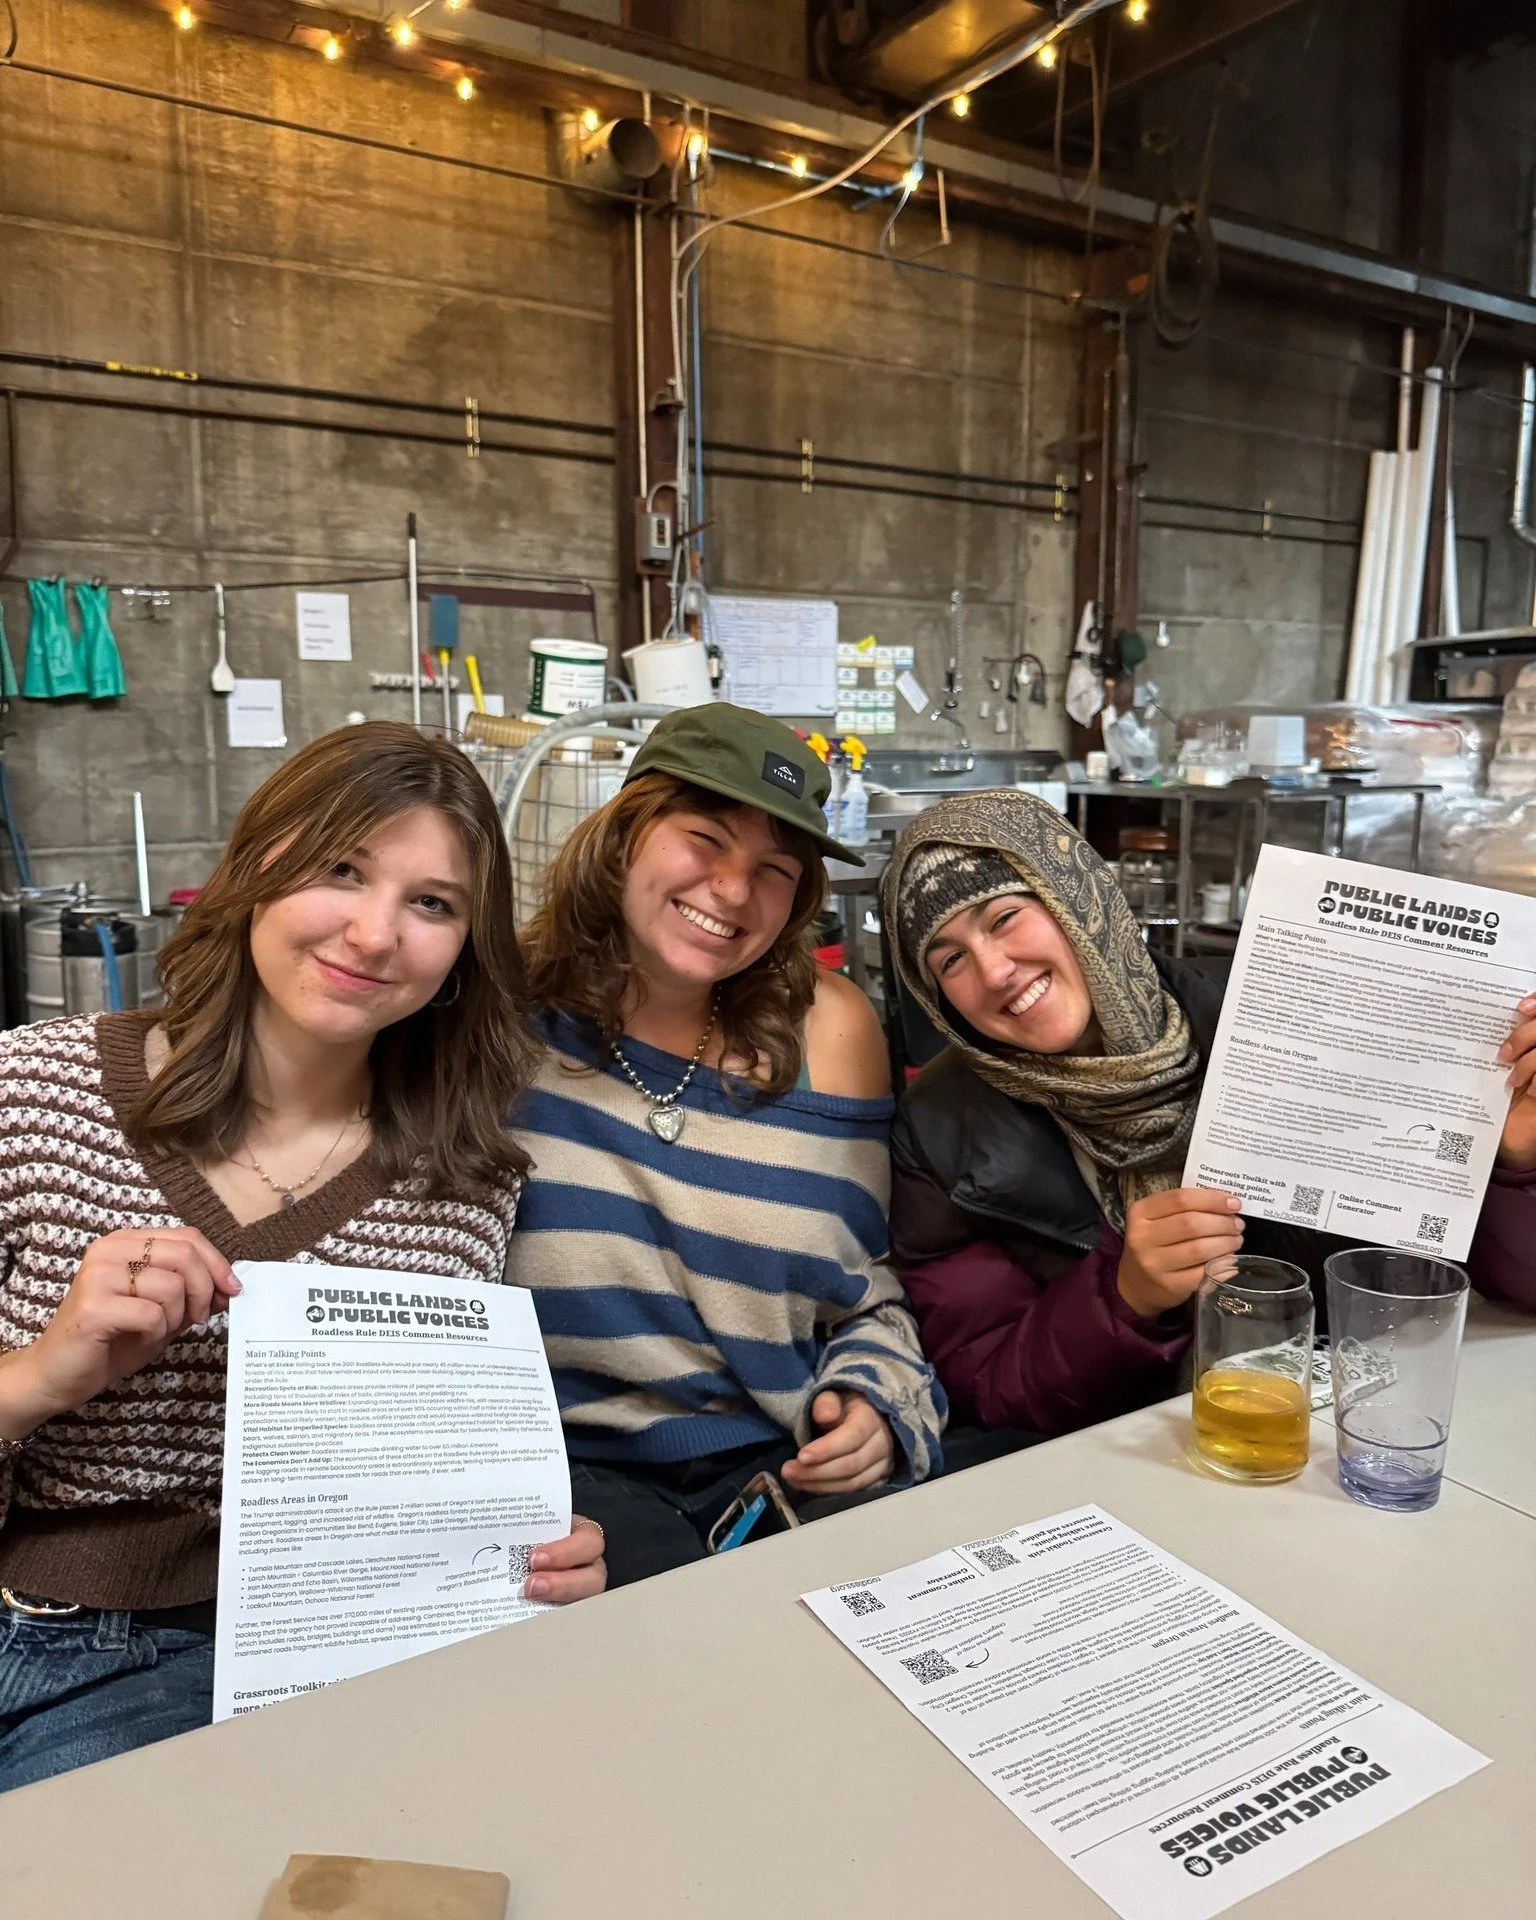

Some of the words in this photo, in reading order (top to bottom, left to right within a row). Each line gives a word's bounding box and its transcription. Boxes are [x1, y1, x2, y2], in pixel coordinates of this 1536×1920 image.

[1324, 880, 1406, 907] PUBLIC
[1408, 898, 1482, 924] LANDS
[1337, 902, 1418, 930] PUBLIC
[1422, 919, 1498, 946] VOICES
[1257, 924, 1275, 933] Main
[1277, 928, 1304, 940] Talking
[1304, 934, 1327, 944] Points
[1318, 917, 1357, 931] Roadless
[1359, 926, 1379, 935] Rule
[1381, 930, 1402, 940] DEIS
[1403, 935, 1444, 949] Comment
[1446, 944, 1488, 958] Resources
[1230, 1036, 1260, 1048] Roadless
[1262, 1044, 1282, 1054] Areas
[1292, 1050, 1318, 1061] Oregon
[1198, 1173, 1218, 1183] more
[1219, 1179, 1244, 1190] talking
[1246, 1184, 1271, 1194] points,
[1200, 1164, 1240, 1179] Grassroots
[1242, 1174, 1268, 1184] Toolkit
[1269, 1179, 1286, 1187] with
[1248, 1194, 1275, 1204] guides!
[1339, 1193, 1364, 1204] Online
[1366, 1200, 1402, 1212] Comment
[1337, 1203, 1375, 1216] Generator
[1396, 1240, 1442, 1254] roadless.org
[308, 1288, 392, 1306] PUBLIC
[396, 1293, 468, 1311] LANDS
[328, 1308, 411, 1324] PUBLIC
[414, 1312, 489, 1330] VOICES
[312, 1328, 353, 1336] Roadless
[402, 1331, 444, 1339] Comment
[446, 1333, 488, 1342] Resources
[268, 1350, 299, 1359] Talking
[240, 1498, 279, 1507] Roadless
[318, 1494, 348, 1503] Oregon
[1060, 1515, 1096, 1529] resources
[1084, 1520, 1104, 1529] more
[1019, 1530, 1046, 1545] guides!
[1046, 1526, 1060, 1535] and
[1057, 1526, 1084, 1541] talking
[1072, 1526, 1113, 1545] Grassroots
[1031, 1534, 1057, 1547] points,
[1045, 1538, 1074, 1552] Toolkit
[1028, 1548, 1046, 1558] with
[445, 1572, 476, 1581] Interactive
[926, 1568, 968, 1585] Generator
[948, 1574, 976, 1586] Online
[299, 1586, 355, 1595] Wallowa-Whitman
[436, 1582, 463, 1592] Oregon's
[464, 1578, 489, 1586] Roadless
[829, 1577, 881, 1593] roadless.org
[907, 1584, 948, 1601] Comment
[1206, 1610, 1240, 1626] Roadless
[982, 1622, 1006, 1635] Oregon's
[1186, 1623, 1208, 1634] Areas
[958, 1634, 983, 1646] Roadless
[976, 1631, 1004, 1646] Interactive
[1151, 1633, 1180, 1649] Oregon
[962, 1644, 976, 1652] map
[233, 1686, 289, 1699] Grassroots
[290, 1680, 326, 1693] Toolkit
[1350, 1693, 1371, 1707] Main
[1321, 1699, 1352, 1720] Talking
[1299, 1714, 1325, 1730] Points
[1297, 1736, 1341, 1762] Roadless
[1276, 1757, 1299, 1773] Rule
[1250, 1769, 1277, 1786] DEIS
[1252, 1756, 1350, 1810] PUBLIC
[1202, 1782, 1252, 1809] Comment
[1293, 1763, 1392, 1818] PUBLIC
[1149, 1805, 1204, 1836] Resources
[1160, 1803, 1263, 1859] VOICES
[1207, 1809, 1304, 1865] LANDS
